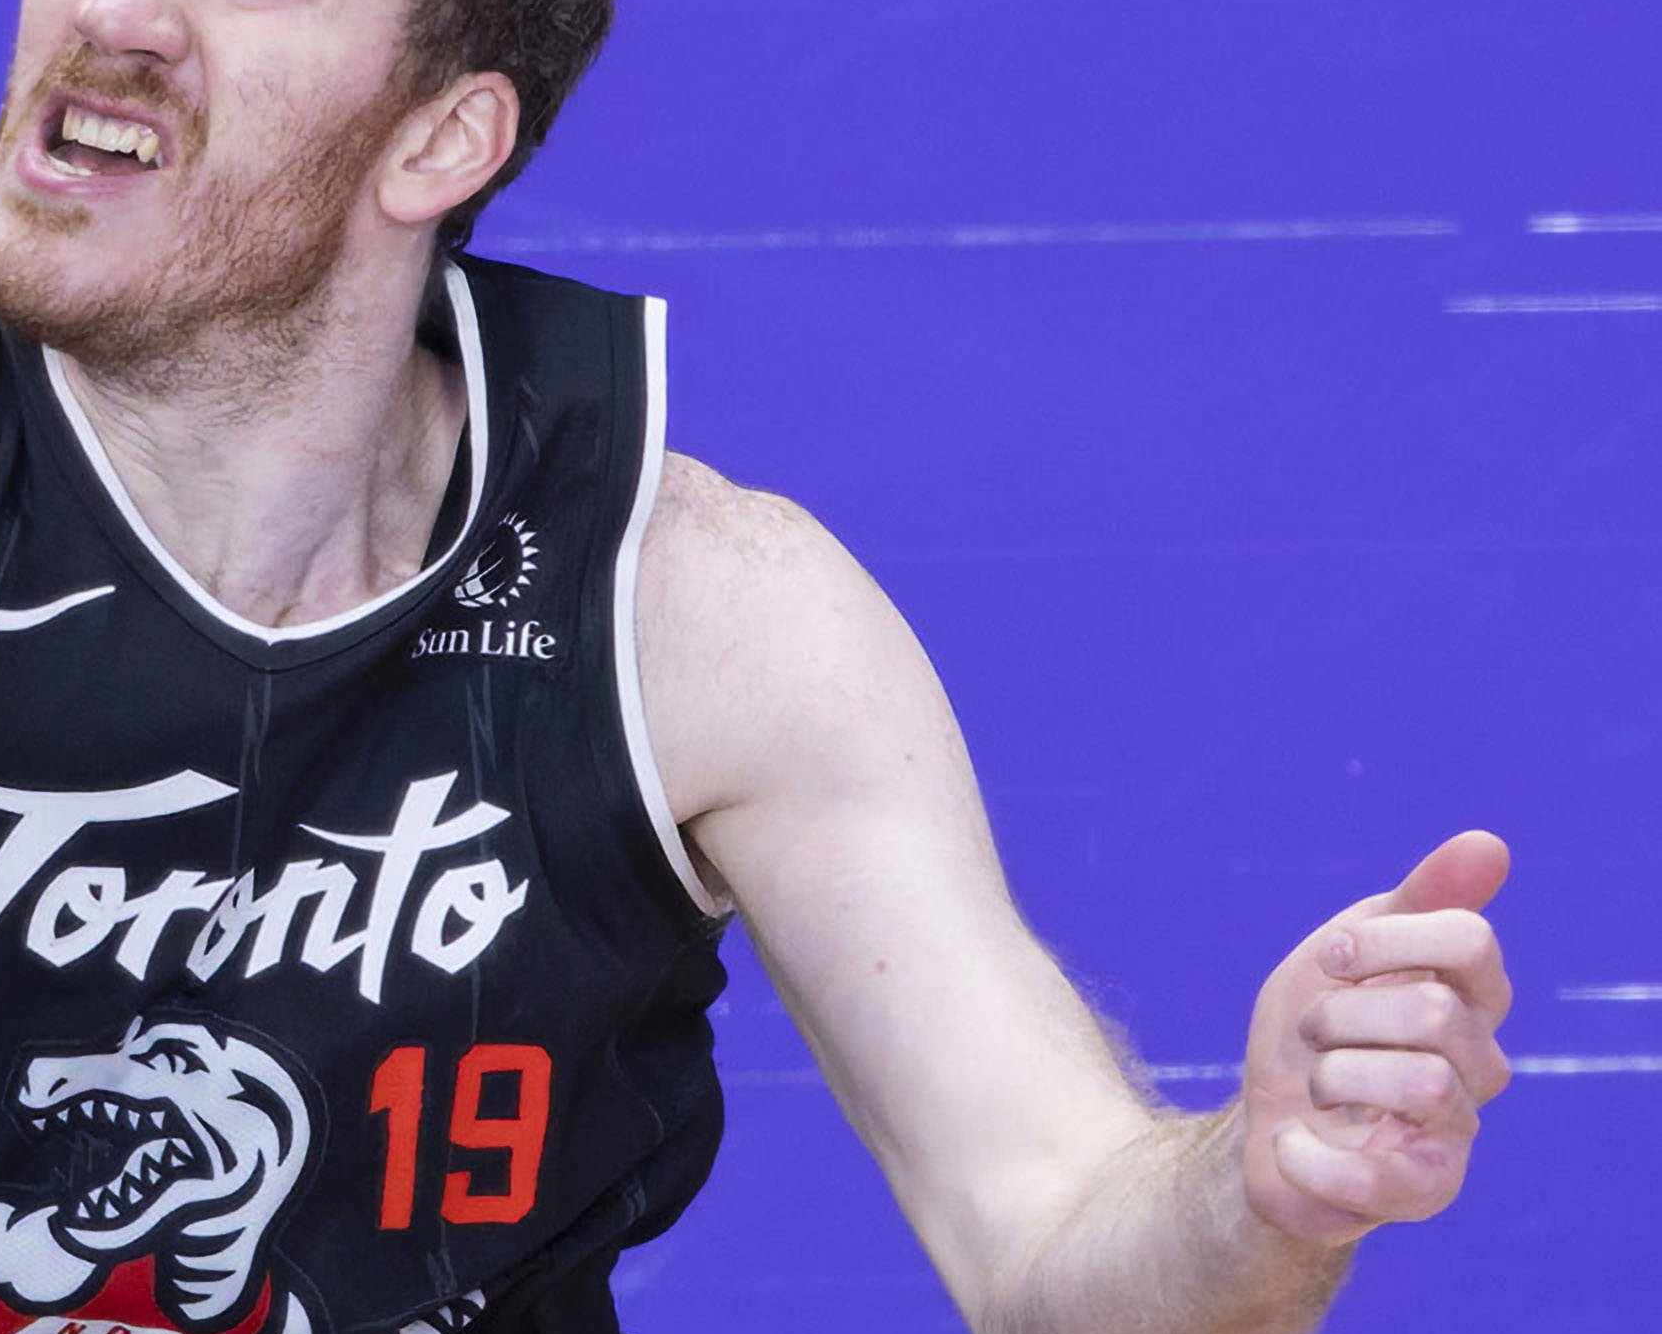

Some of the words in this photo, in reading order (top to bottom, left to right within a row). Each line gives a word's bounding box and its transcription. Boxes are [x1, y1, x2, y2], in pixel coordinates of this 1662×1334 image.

[411, 628, 469, 659] Sun
[480, 620, 556, 659] Life
[370, 1043, 552, 1230] 19
